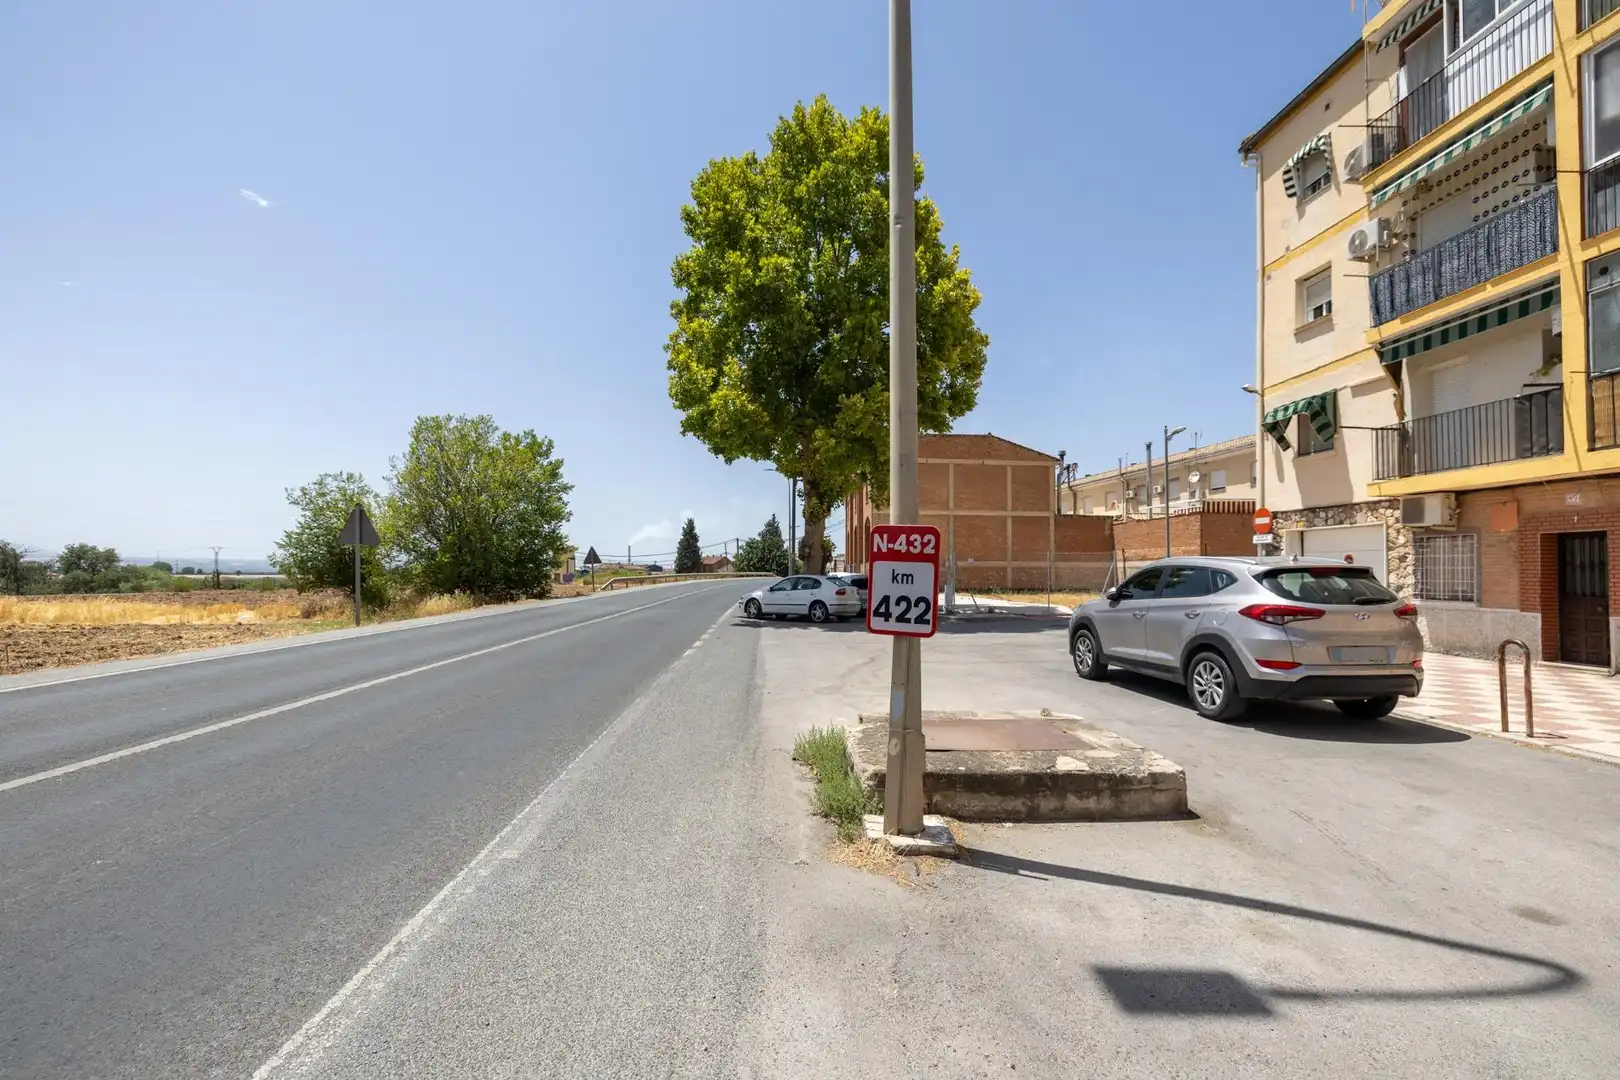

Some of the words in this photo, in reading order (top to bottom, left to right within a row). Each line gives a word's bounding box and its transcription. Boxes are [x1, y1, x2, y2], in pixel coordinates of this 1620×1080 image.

[873, 533, 936, 554] N-432
[891, 568, 914, 585] km
[872, 594, 932, 626] 422
